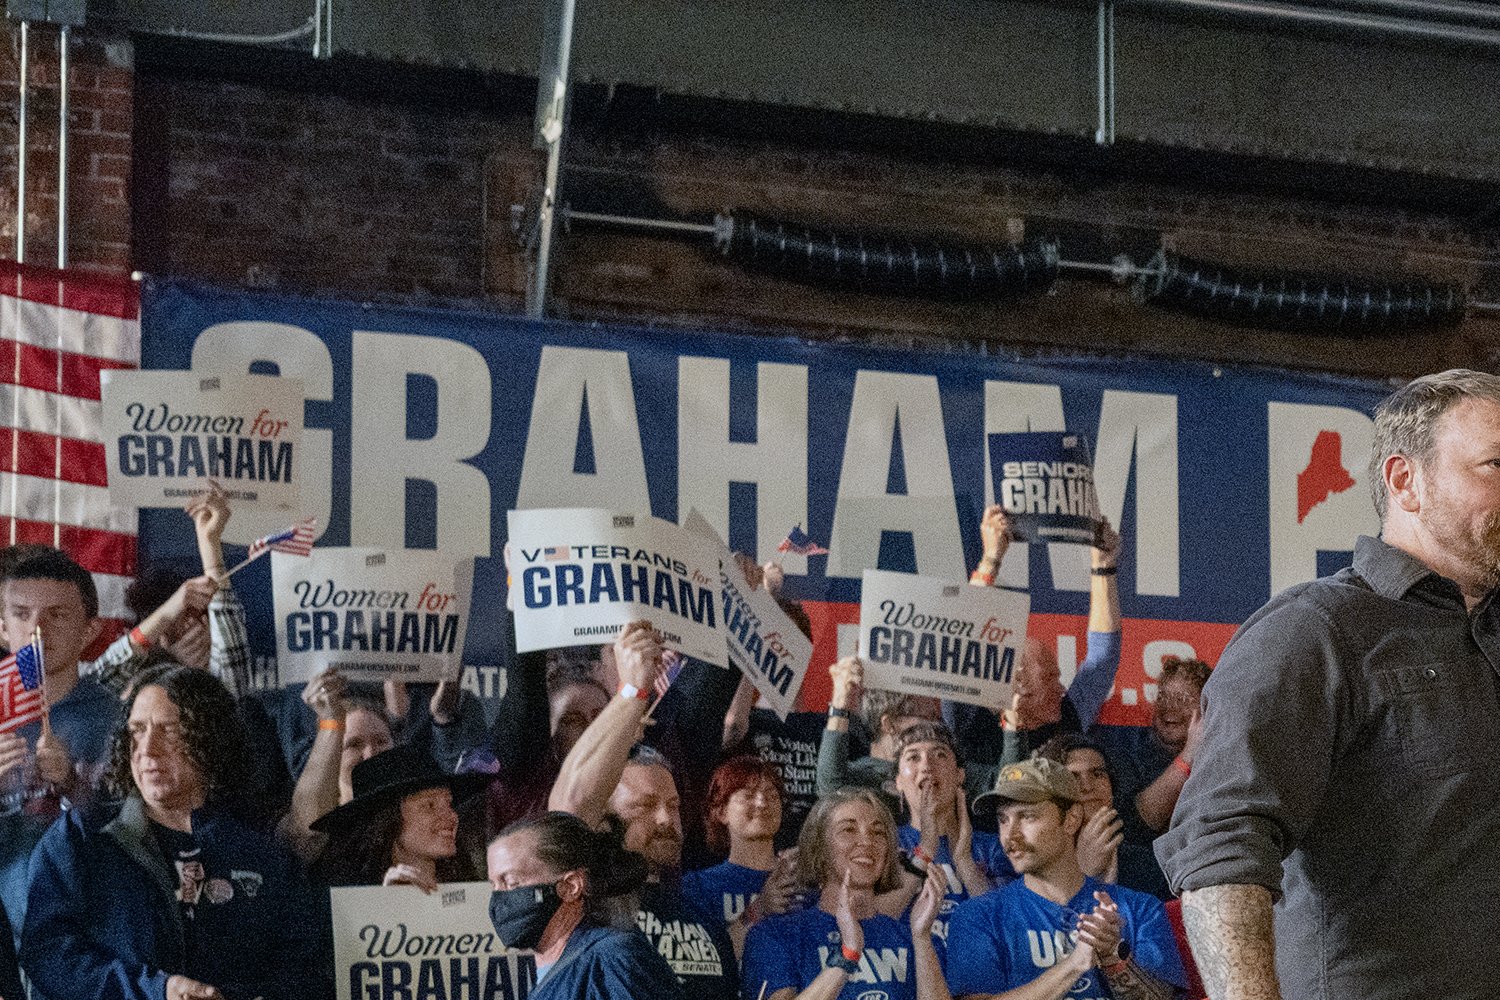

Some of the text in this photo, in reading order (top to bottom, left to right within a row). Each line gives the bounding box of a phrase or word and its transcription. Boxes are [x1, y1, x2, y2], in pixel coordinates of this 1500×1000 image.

[126, 402, 288, 438] Women for
[118, 434, 293, 483] GRAHAM
[190, 321, 1180, 598] GRAHAM
[1002, 461, 1093, 482] SENIOR
[521, 545, 687, 576] VTERANS
[294, 579, 457, 611] Women for
[523, 562, 716, 629] GRAHAM
[719, 558, 762, 629] omen
[286, 610, 460, 653] GRAHAM
[880, 599, 1013, 643] Women for
[869, 626, 1015, 684] GRAHAM
[359, 923, 495, 958] Women
